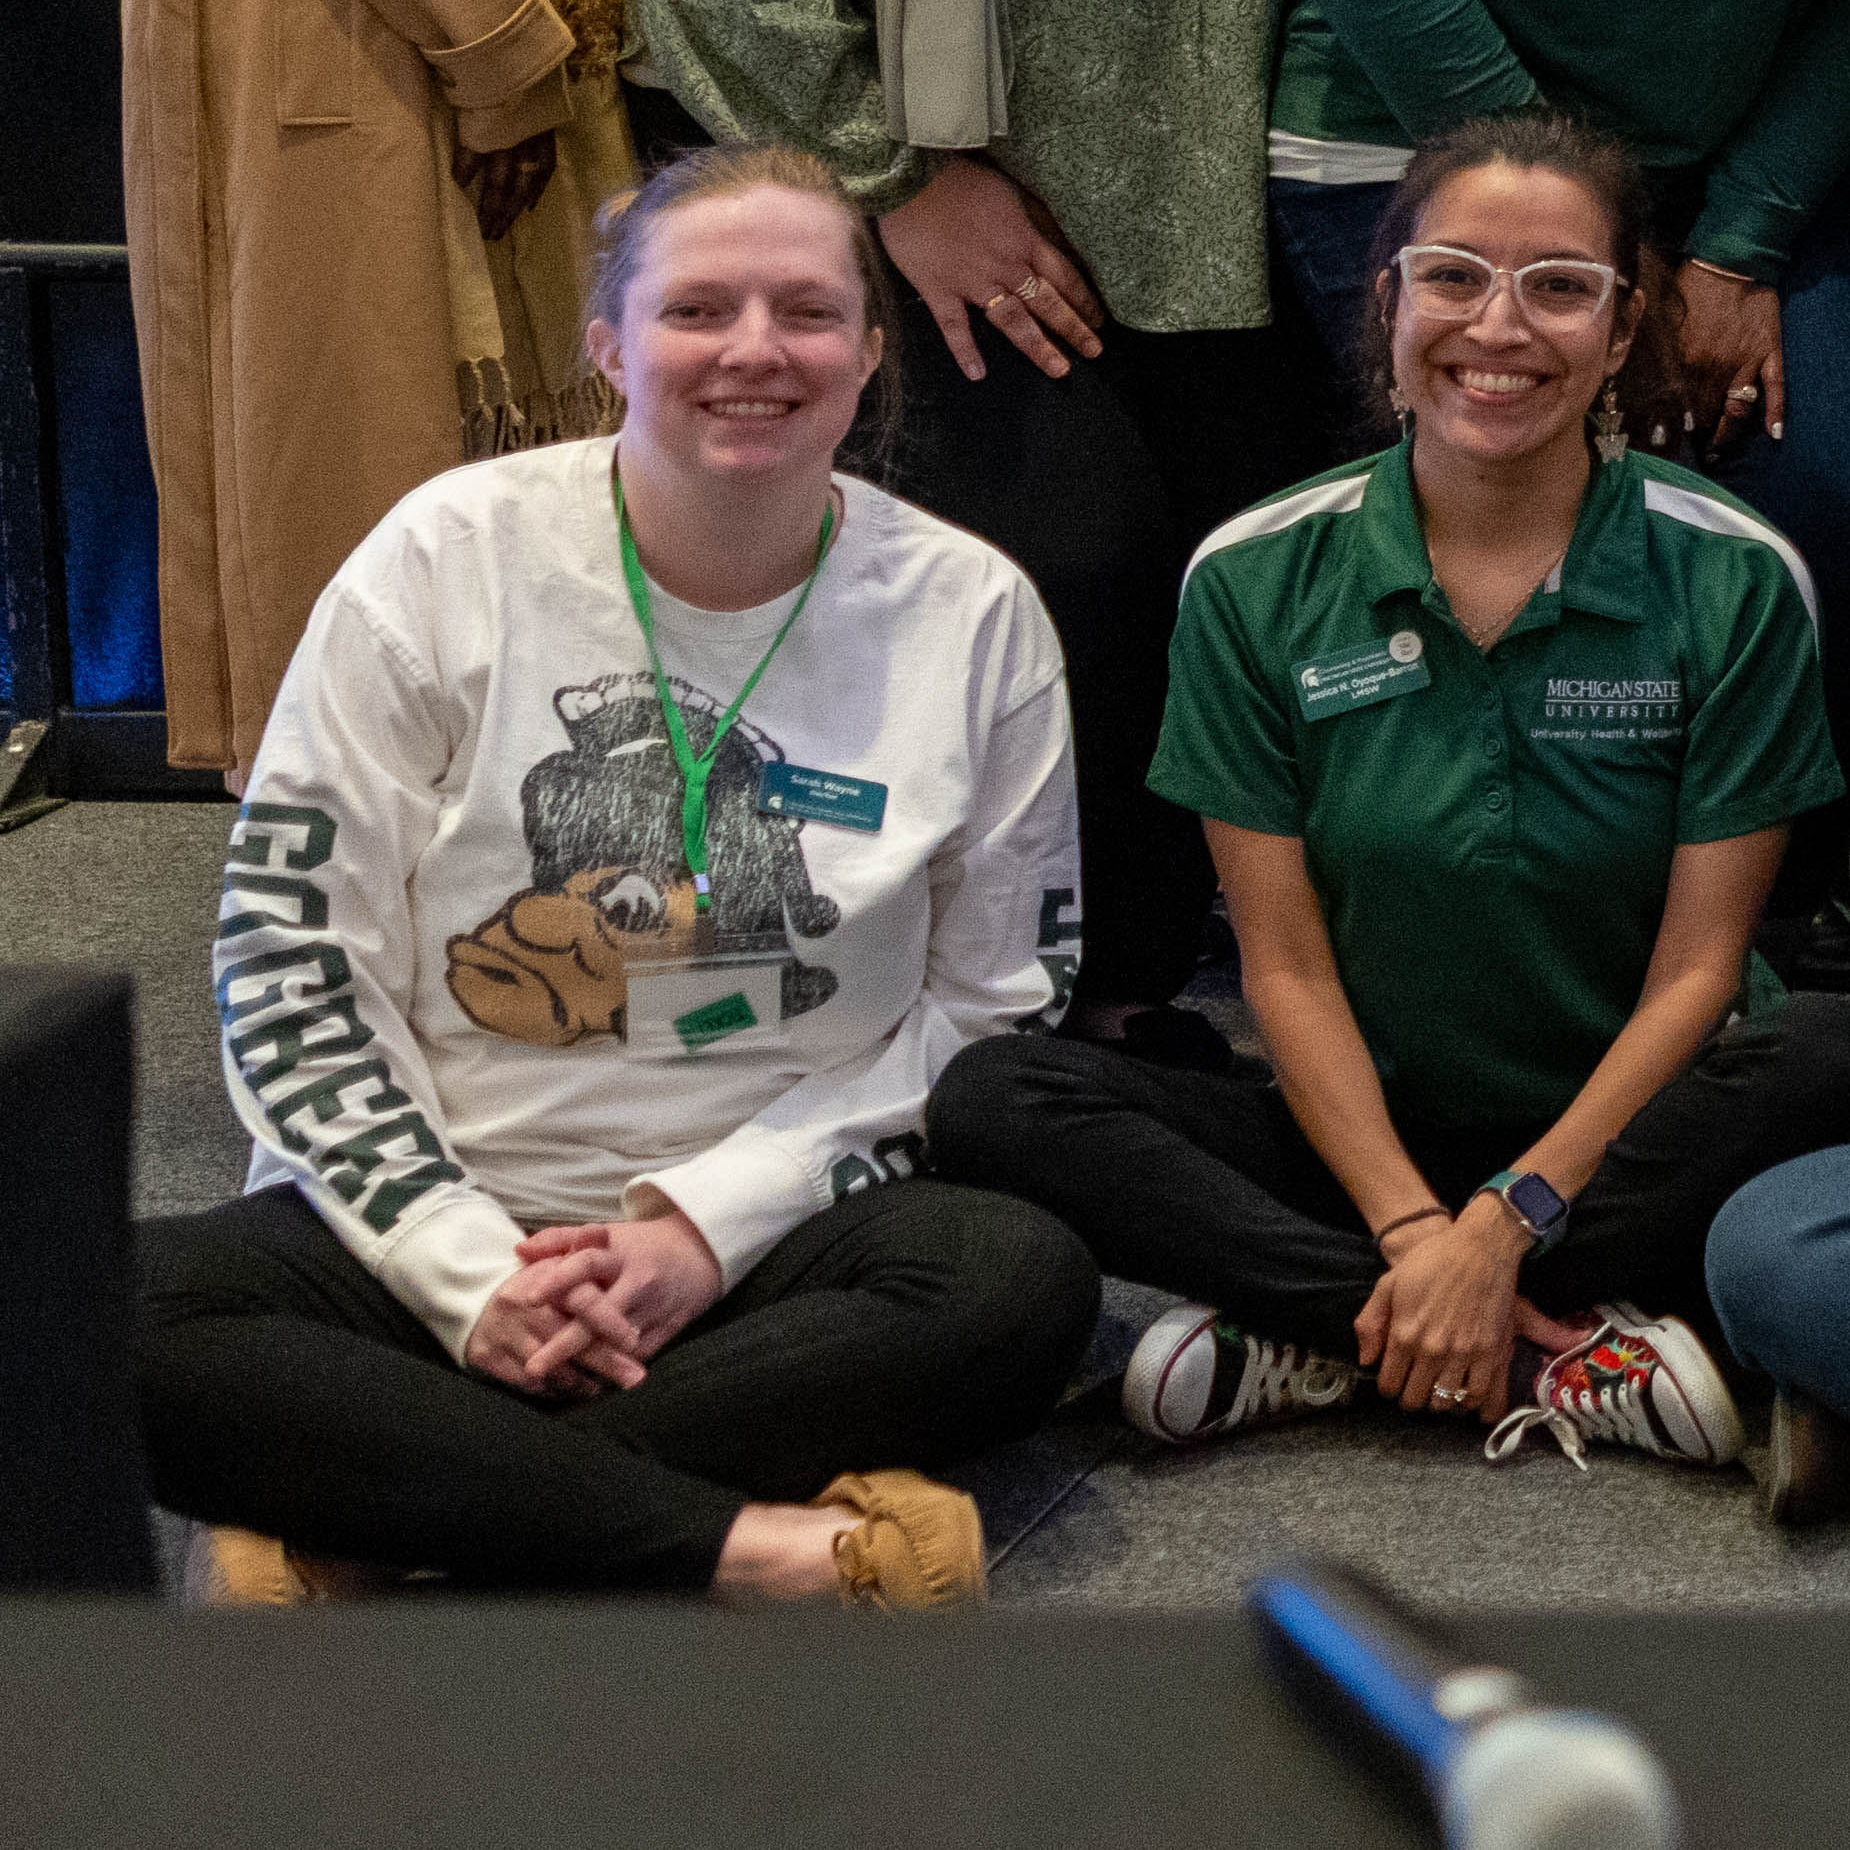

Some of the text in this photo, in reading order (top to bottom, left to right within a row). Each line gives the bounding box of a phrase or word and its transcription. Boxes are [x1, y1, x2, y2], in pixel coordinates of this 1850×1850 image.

[1547, 680, 1681, 697] MICHIGAN STATE
[1545, 705, 1679, 717] UNIVERSITY
